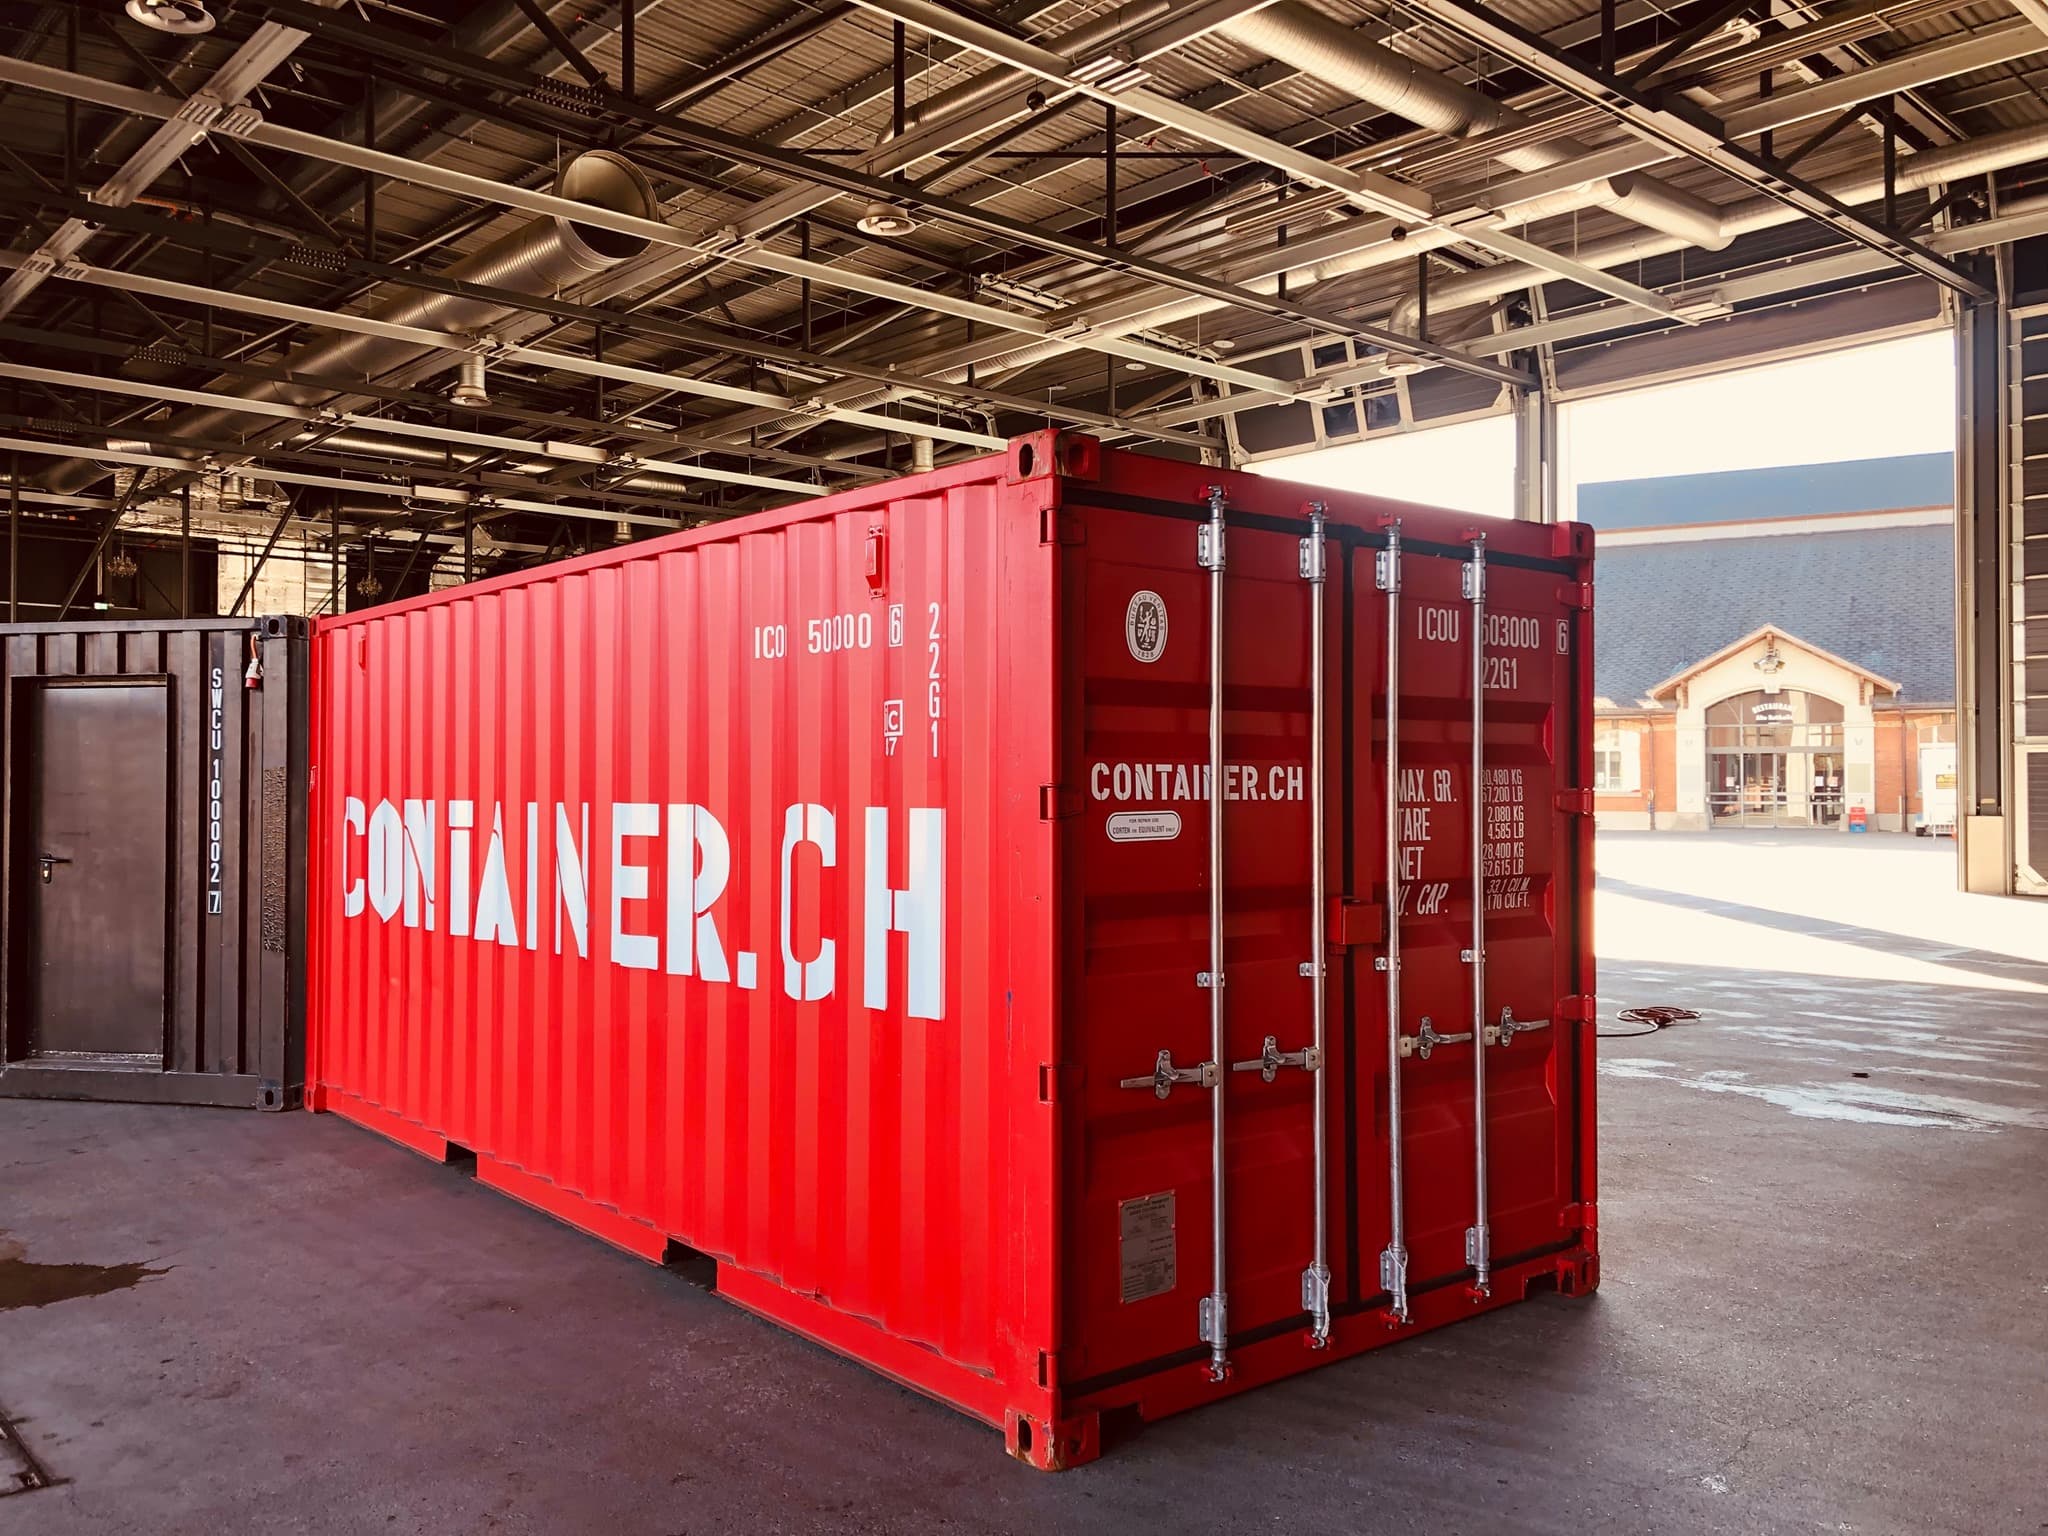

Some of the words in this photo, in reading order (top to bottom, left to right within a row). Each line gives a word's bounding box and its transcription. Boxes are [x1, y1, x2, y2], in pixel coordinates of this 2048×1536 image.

[1418, 607, 1459, 642] ICOU
[1557, 620, 1568, 653] 6
[1482, 657, 1517, 689] 22G1
[211, 668, 223, 750] SWCU
[1397, 769, 1431, 802] MAX.
[1433, 769, 1457, 802] GR.
[1511, 769, 1523, 785] KG
[1512, 786, 1524, 802] LB
[211, 758, 222, 883] 100002
[1397, 808, 1431, 841] TARE
[1513, 805, 1524, 821] KG
[1514, 822, 1524, 839] LB
[1398, 847, 1424, 880] NET
[1513, 841, 1524, 858] KG
[1513, 859, 1524, 875] LB
[343, 796, 946, 1021] CONTAINER.CH
[1417, 883, 1449, 915] CAP.
